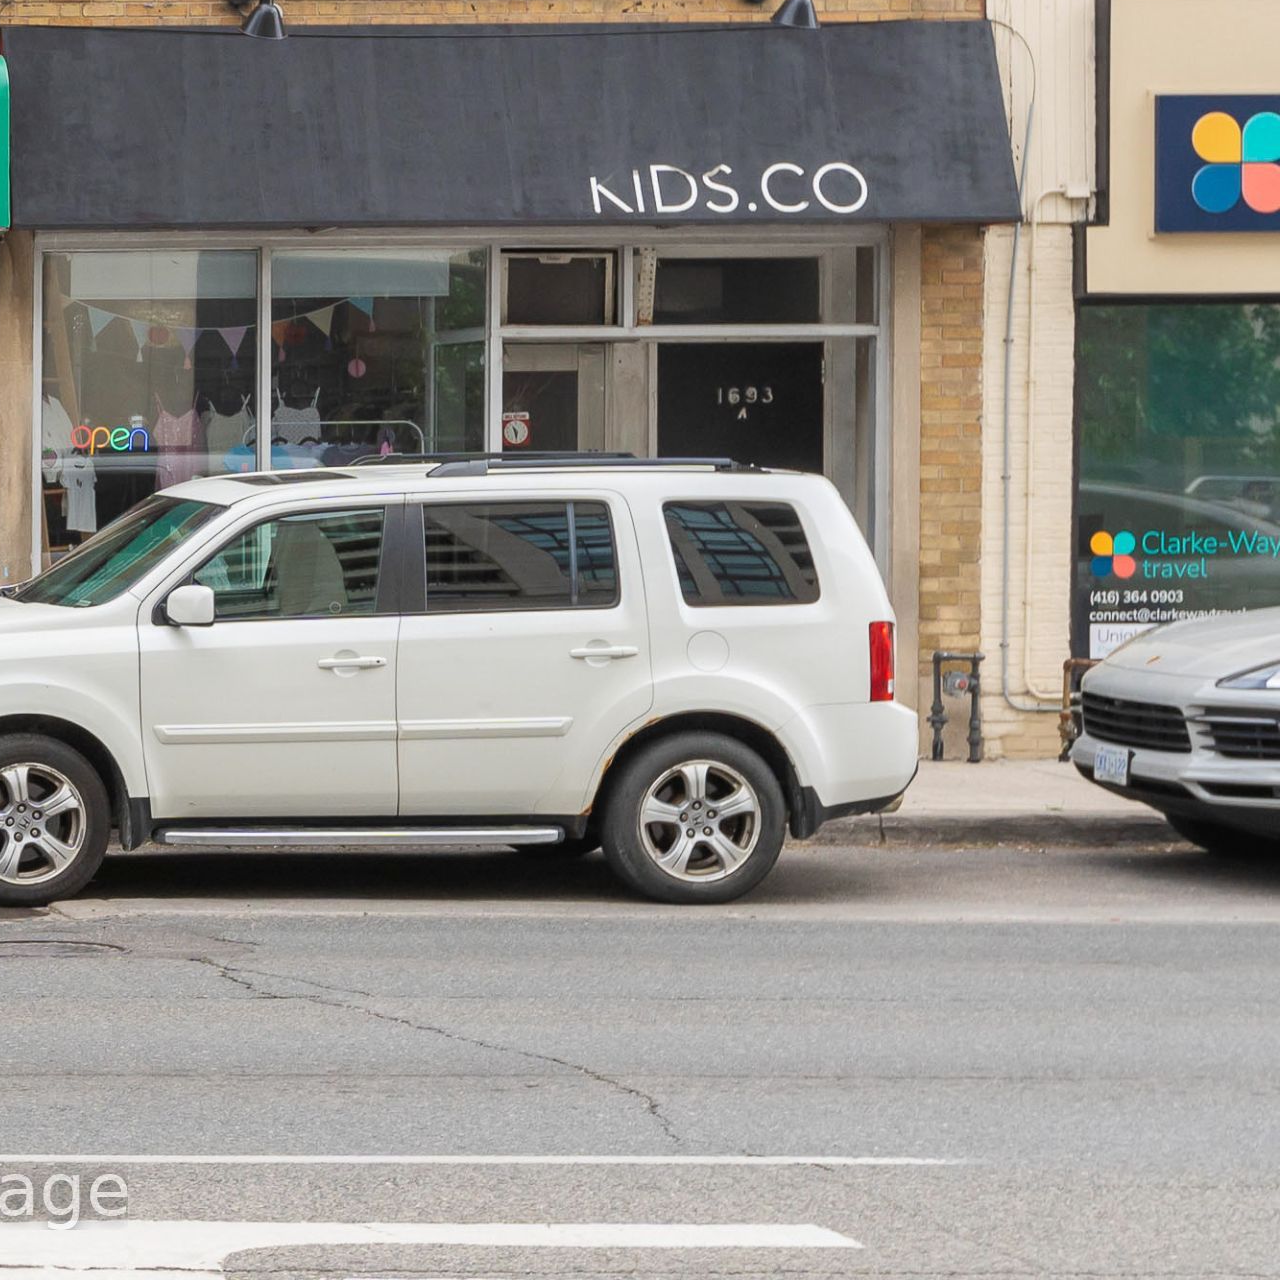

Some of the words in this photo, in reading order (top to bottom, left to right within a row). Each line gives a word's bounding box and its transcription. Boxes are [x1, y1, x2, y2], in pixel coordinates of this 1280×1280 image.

[590, 162, 868, 213] KIDS.CO
[717, 387, 774, 405] 1693
[70, 425, 149, 456] open
[1142, 530, 1280, 558] Clarke-Way
[1142, 558, 1208, 578] travel
[1090, 590, 1120, 605] (416)
[1123, 590, 1148, 604] 364
[1150, 589, 1184, 604] 0903
